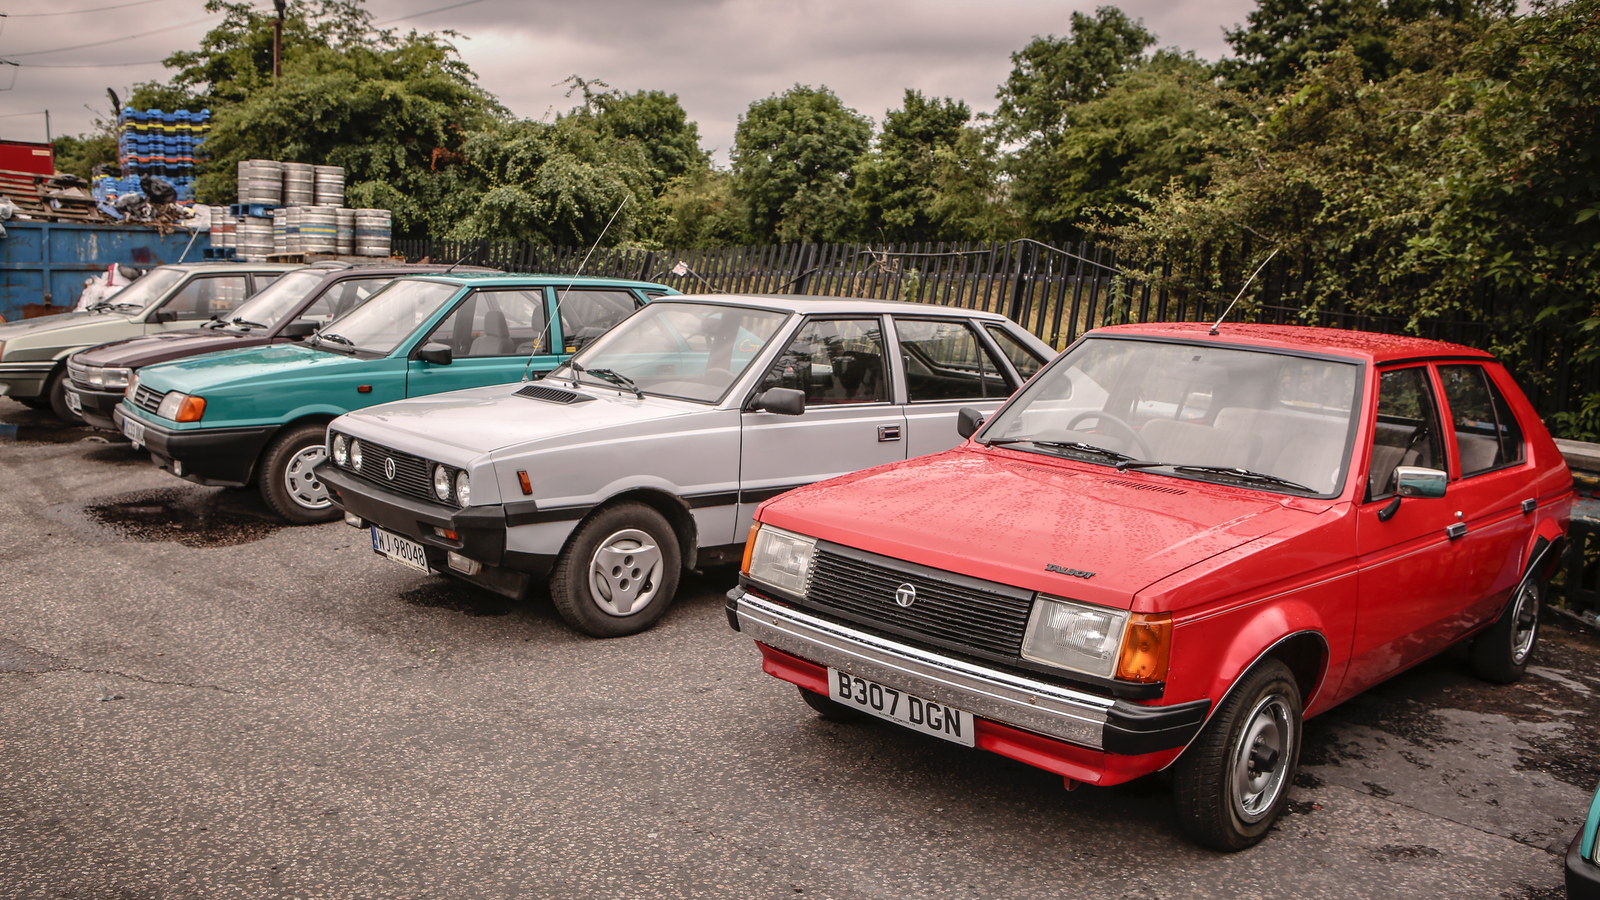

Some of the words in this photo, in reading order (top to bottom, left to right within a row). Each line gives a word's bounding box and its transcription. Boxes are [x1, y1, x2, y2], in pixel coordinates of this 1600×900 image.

[376, 529, 391, 552] WJ
[394, 537, 425, 567] 98048
[1045, 563, 1097, 580] TALBOT
[837, 671, 900, 716] B307
[907, 695, 962, 738] DGN
